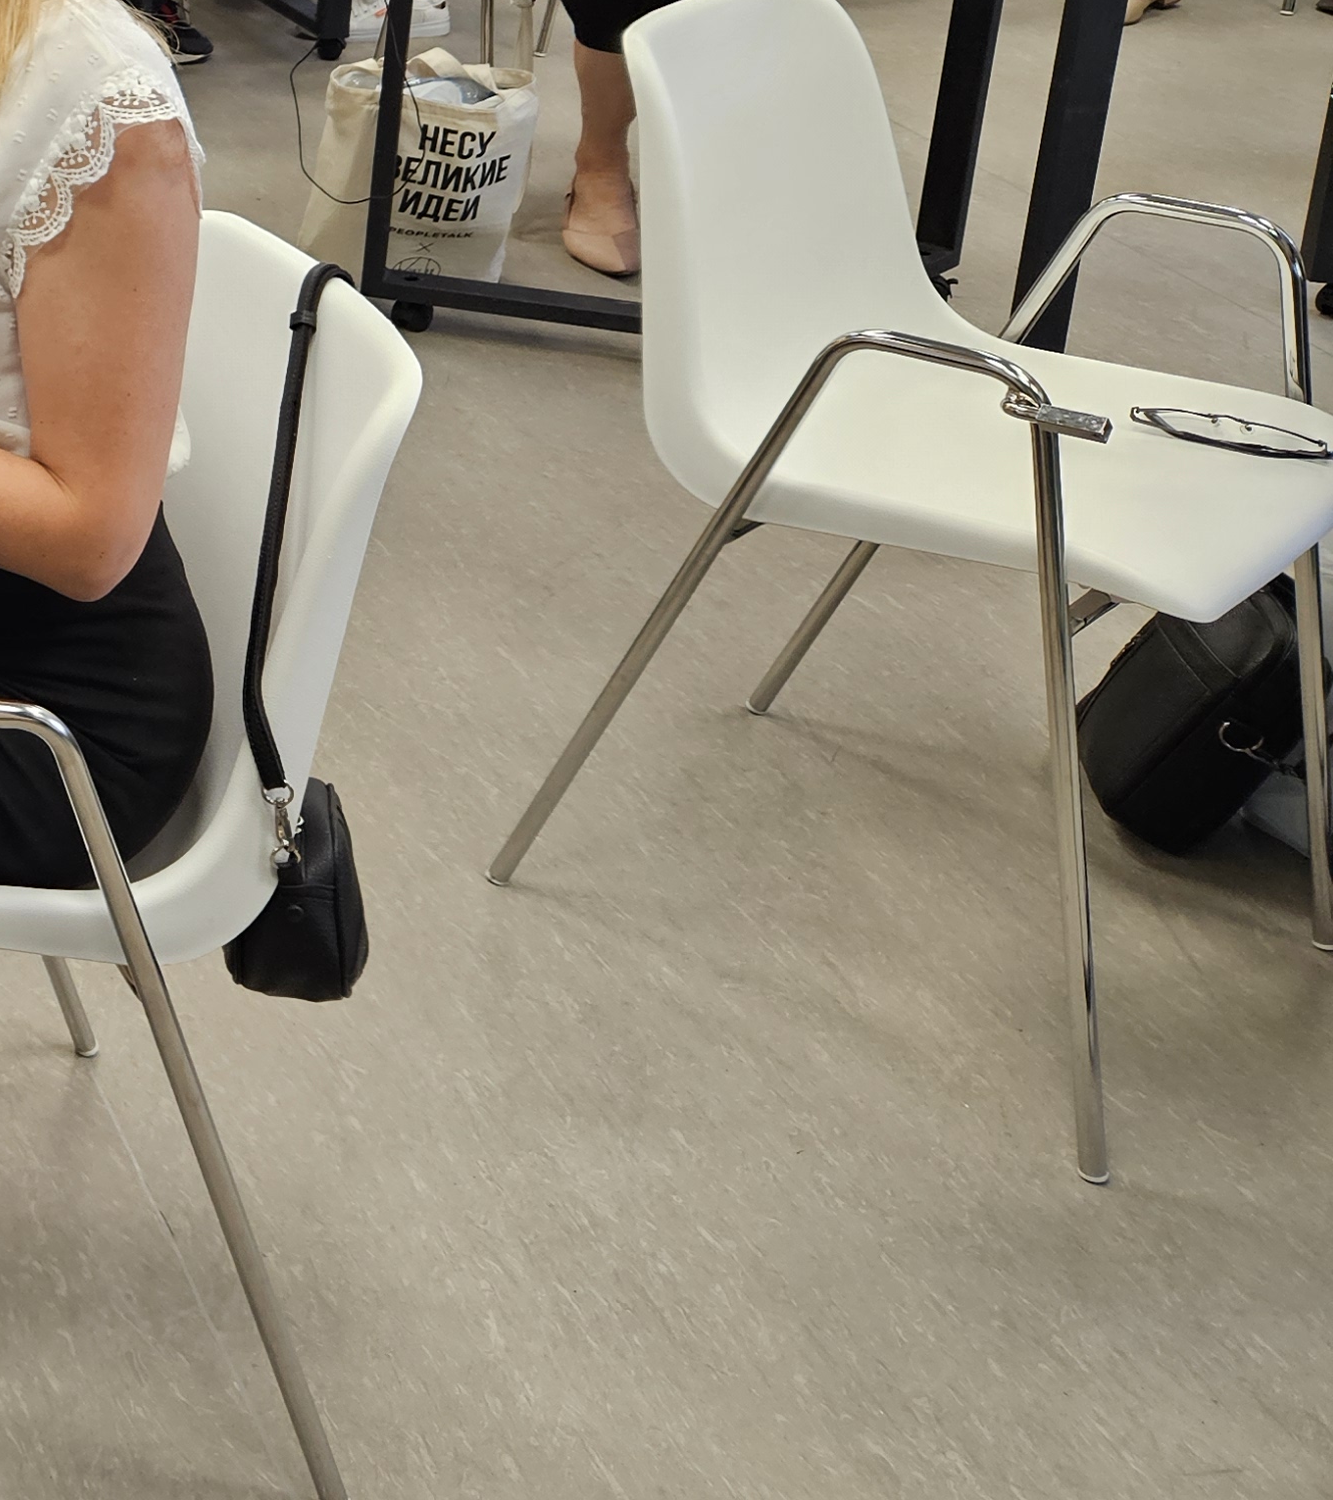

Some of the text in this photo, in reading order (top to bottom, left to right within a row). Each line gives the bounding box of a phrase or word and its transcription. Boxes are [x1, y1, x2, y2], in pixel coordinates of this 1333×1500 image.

[419, 124, 496, 159] НЕСУ
[393, 154, 511, 193] ВЕЛИКИЕ
[398, 188, 481, 222] ИДЕИ
[389, 227, 473, 238] PEOPLETALK
